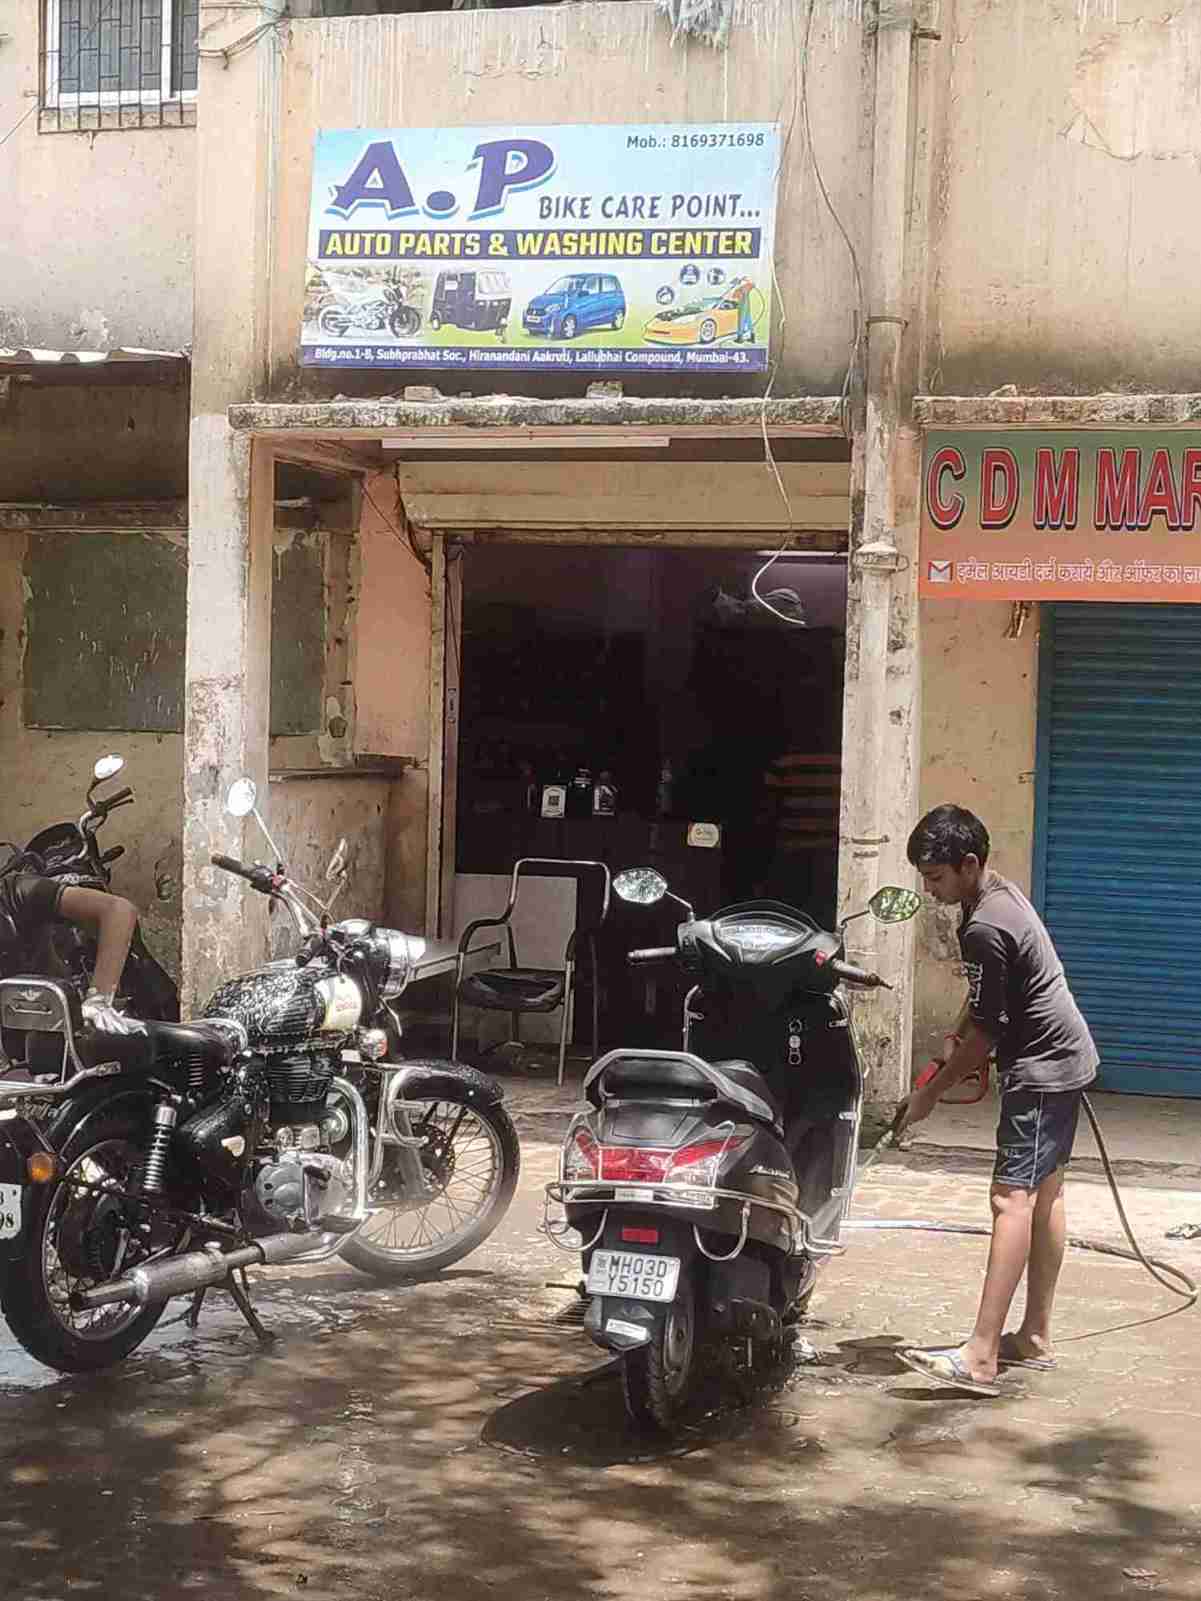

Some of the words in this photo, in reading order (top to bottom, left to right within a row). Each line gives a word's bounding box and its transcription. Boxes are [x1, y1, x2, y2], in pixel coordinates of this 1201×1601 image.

[627, 135, 666, 149] Mob.:
[671, 133, 764, 148] 8169371698
[539, 196, 591, 219] BIKE
[601, 195, 660, 219] CARE
[671, 194, 760, 218] POINT...
[326, 233, 391, 257] AUTO
[400, 233, 481, 256] PARTS
[488, 232, 510, 257] &
[516, 232, 643, 256] WASHING
[651, 231, 752, 256] CENTER
[469, 350, 530, 362] Hiranandani
[625, 351, 683, 364] Compound,
[686, 351, 749, 363] Mumbai-43.
[927, 447, 966, 530] C
[979, 447, 1020, 530] D
[1033, 447, 1080, 530] M
